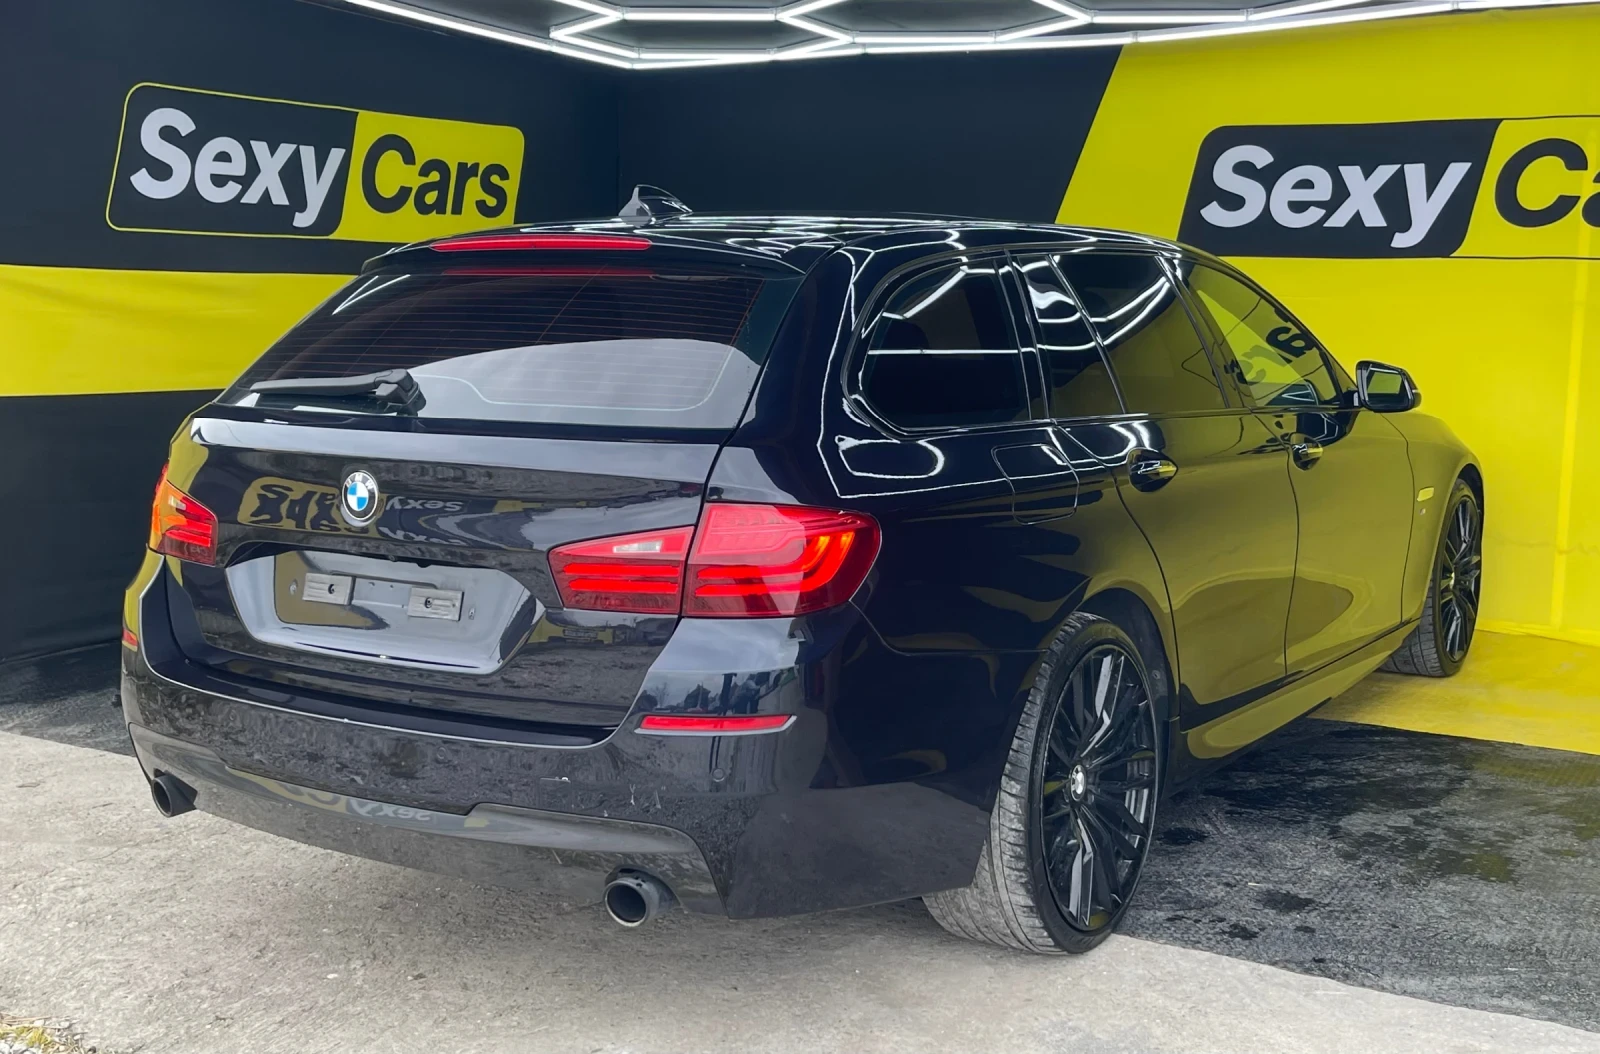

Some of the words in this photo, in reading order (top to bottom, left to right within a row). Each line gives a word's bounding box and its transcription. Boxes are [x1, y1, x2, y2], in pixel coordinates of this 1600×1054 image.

[129, 107, 346, 228] Sexy
[361, 133, 510, 219] Cars
[1199, 144, 1473, 249] Sexy
[1494, 137, 1600, 228] C
